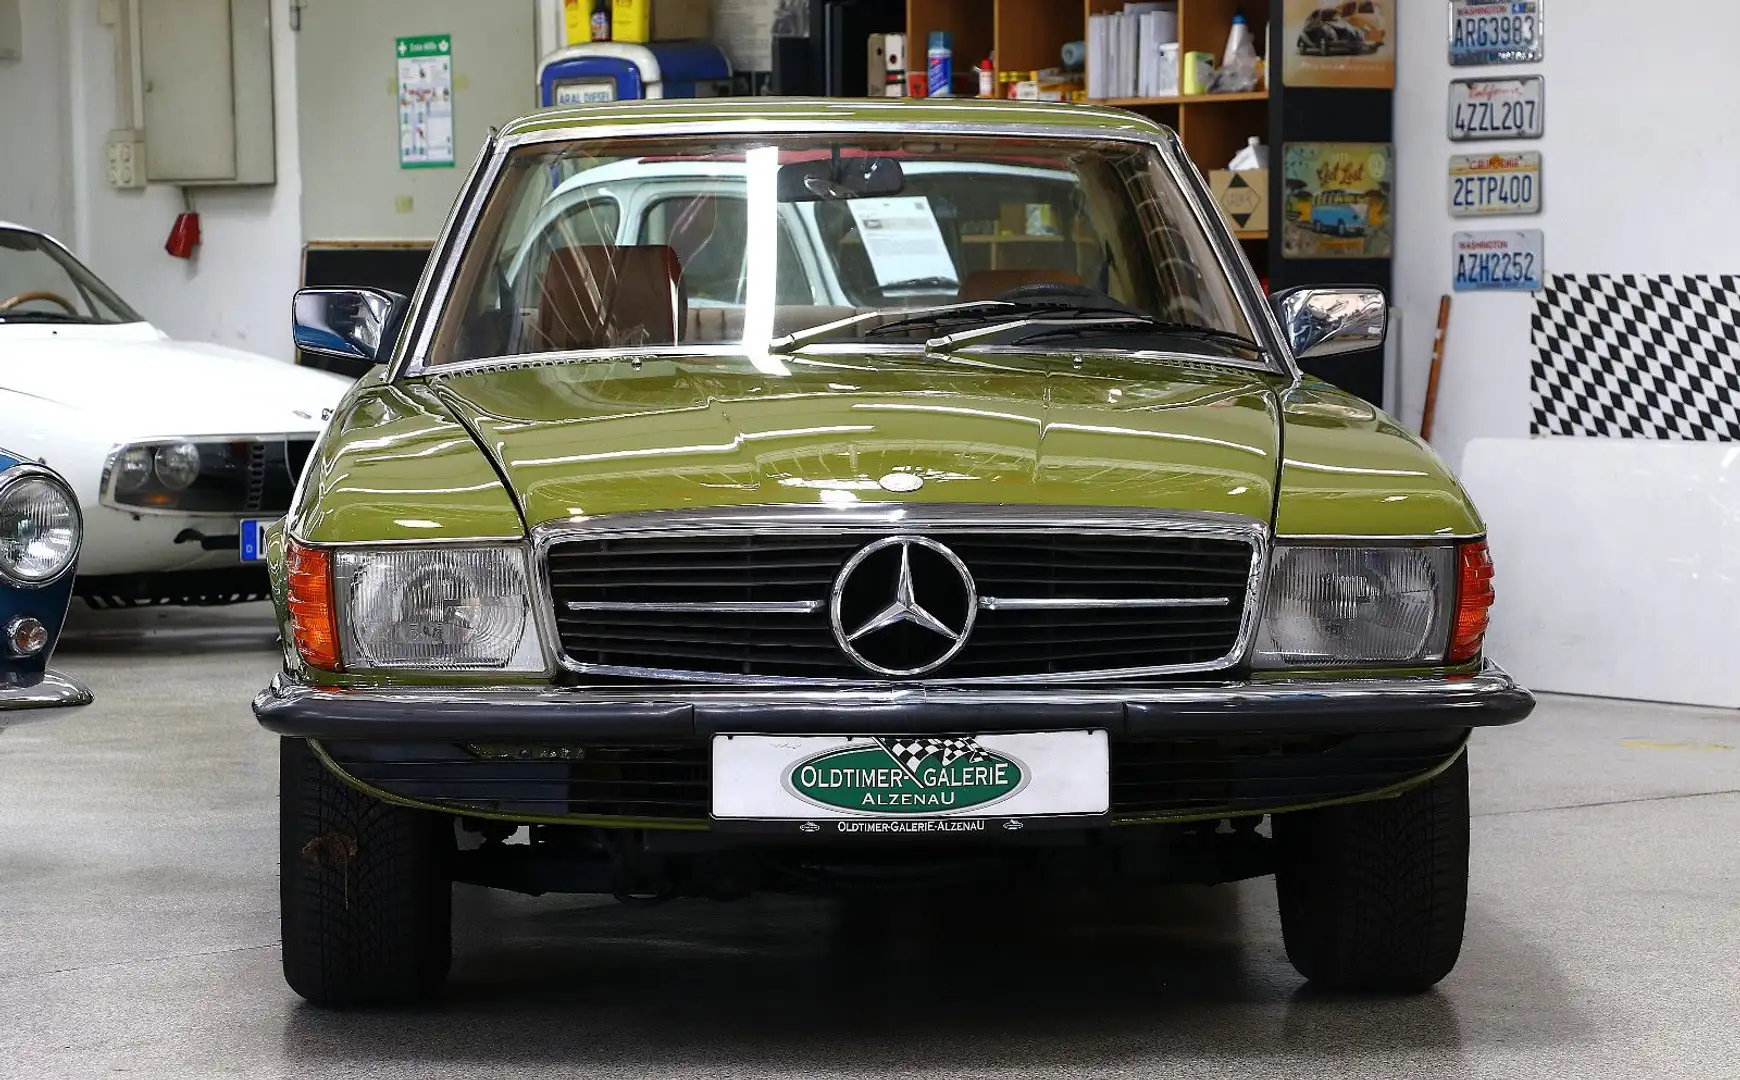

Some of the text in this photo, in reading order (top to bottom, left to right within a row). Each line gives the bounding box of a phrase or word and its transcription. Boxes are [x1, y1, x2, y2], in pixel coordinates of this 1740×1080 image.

[1455, 15, 1534, 47] ARG3983
[1455, 100, 1535, 131] 4ZZL207
[1453, 174, 1532, 206] 2ETP400
[1458, 240, 1508, 250] WASHINGTON
[1457, 252, 1534, 282] AZH2252
[800, 762, 1009, 788] OLDTIMER- GALERIE
[861, 791, 955, 805] ALZENAU
[837, 820, 985, 833] OLDTIMER-GALERIE-ALZENAU
